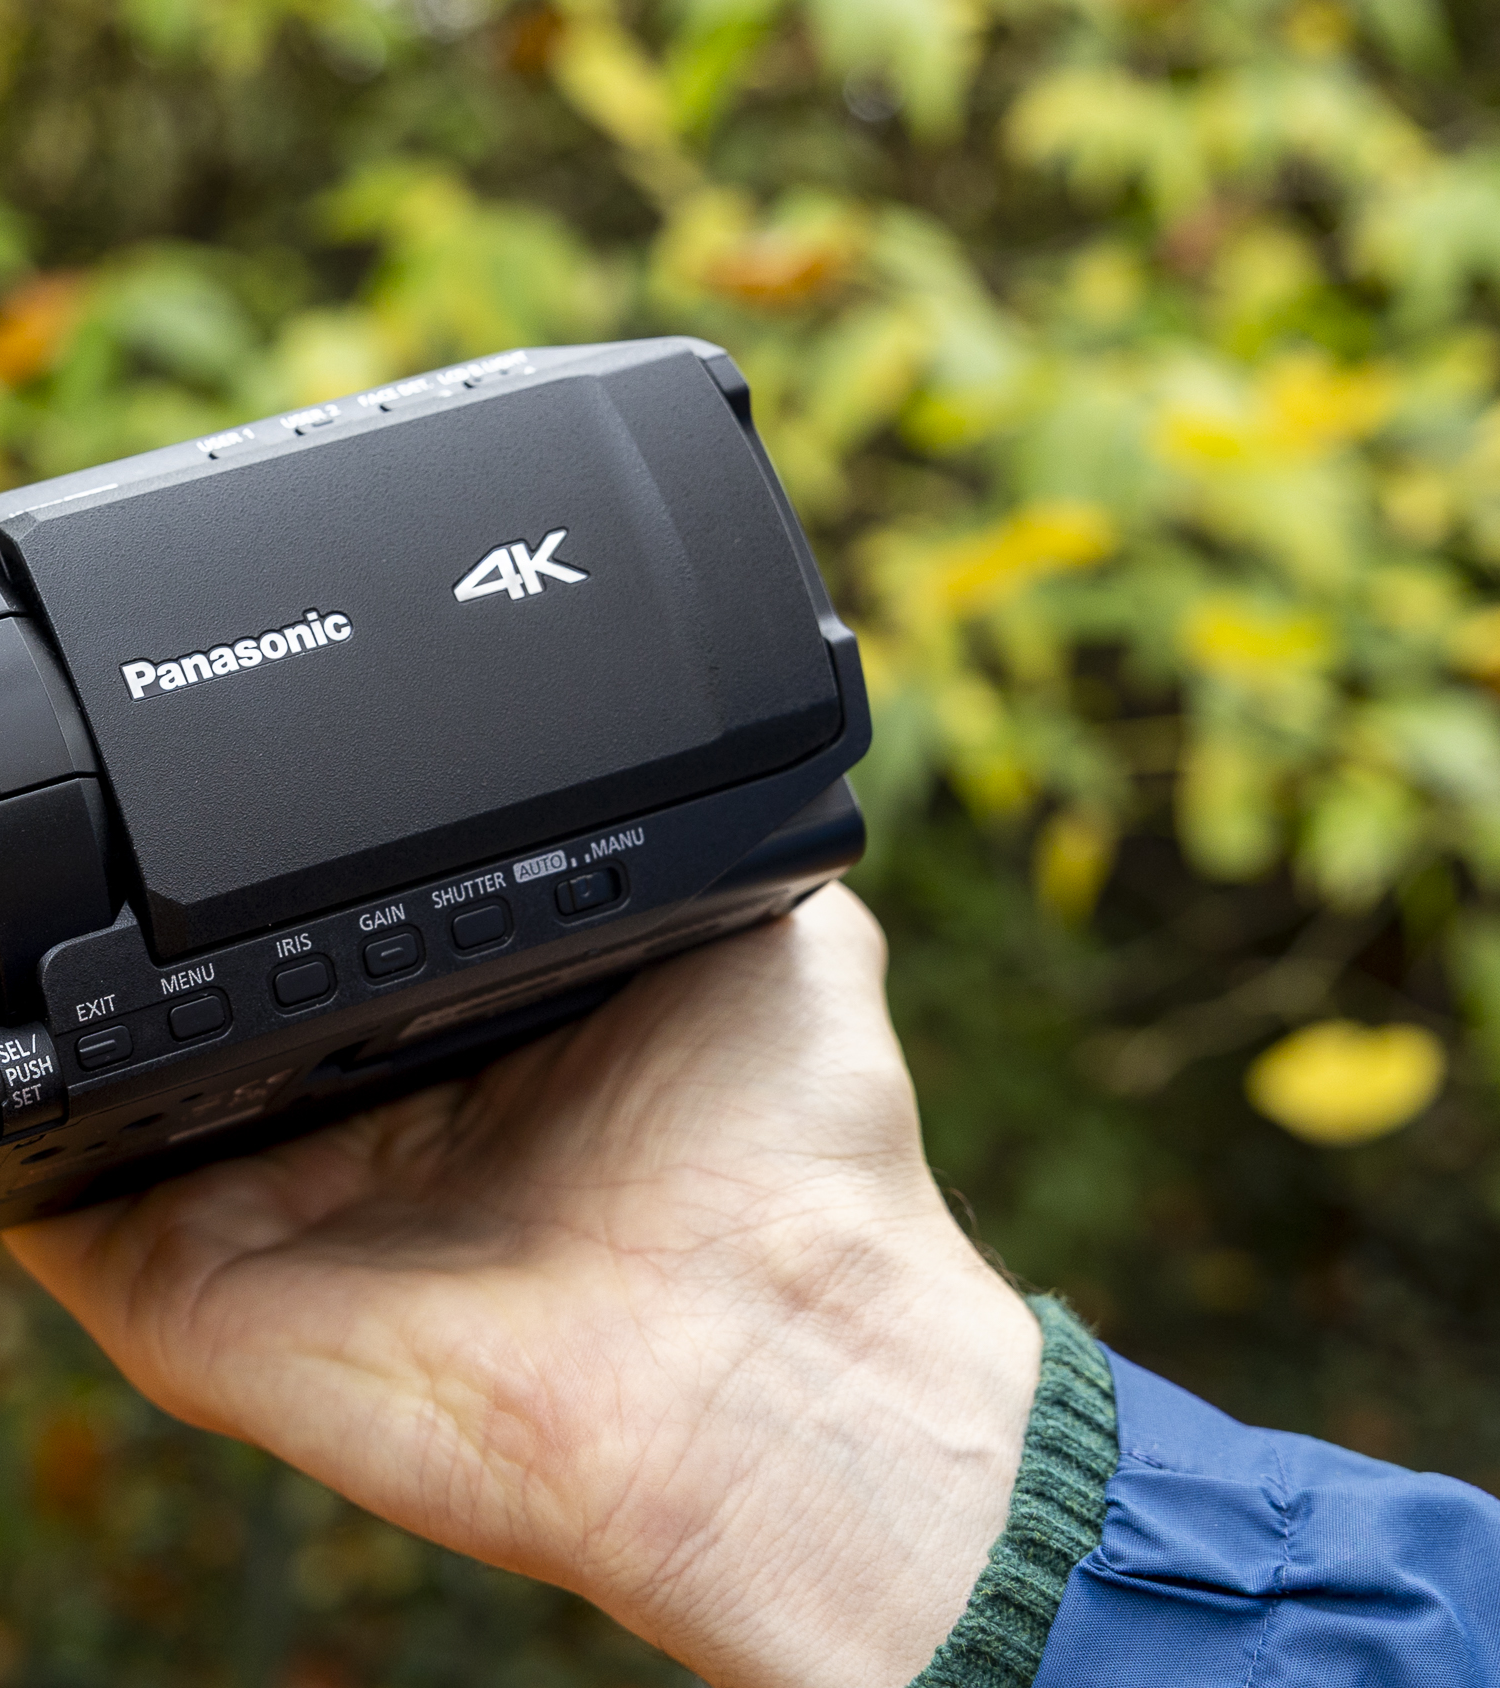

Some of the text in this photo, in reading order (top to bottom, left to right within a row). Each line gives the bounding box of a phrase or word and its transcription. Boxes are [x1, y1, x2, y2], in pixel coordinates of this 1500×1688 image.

[280, 404, 342, 429] USER 2
[196, 428, 255, 453] USER 1
[453, 528, 591, 602] 4K
[120, 611, 353, 700] Panasonic
[518, 827, 645, 880] AUTO MANU
[431, 872, 507, 909] SHUTTER
[359, 903, 406, 931] GAIN
[276, 933, 313, 958] IRIS
[160, 963, 215, 995] MENU
[75, 994, 116, 1022] EXIT
[5, 1055, 54, 1087] PUSH
[12, 1083, 42, 1109] SET
